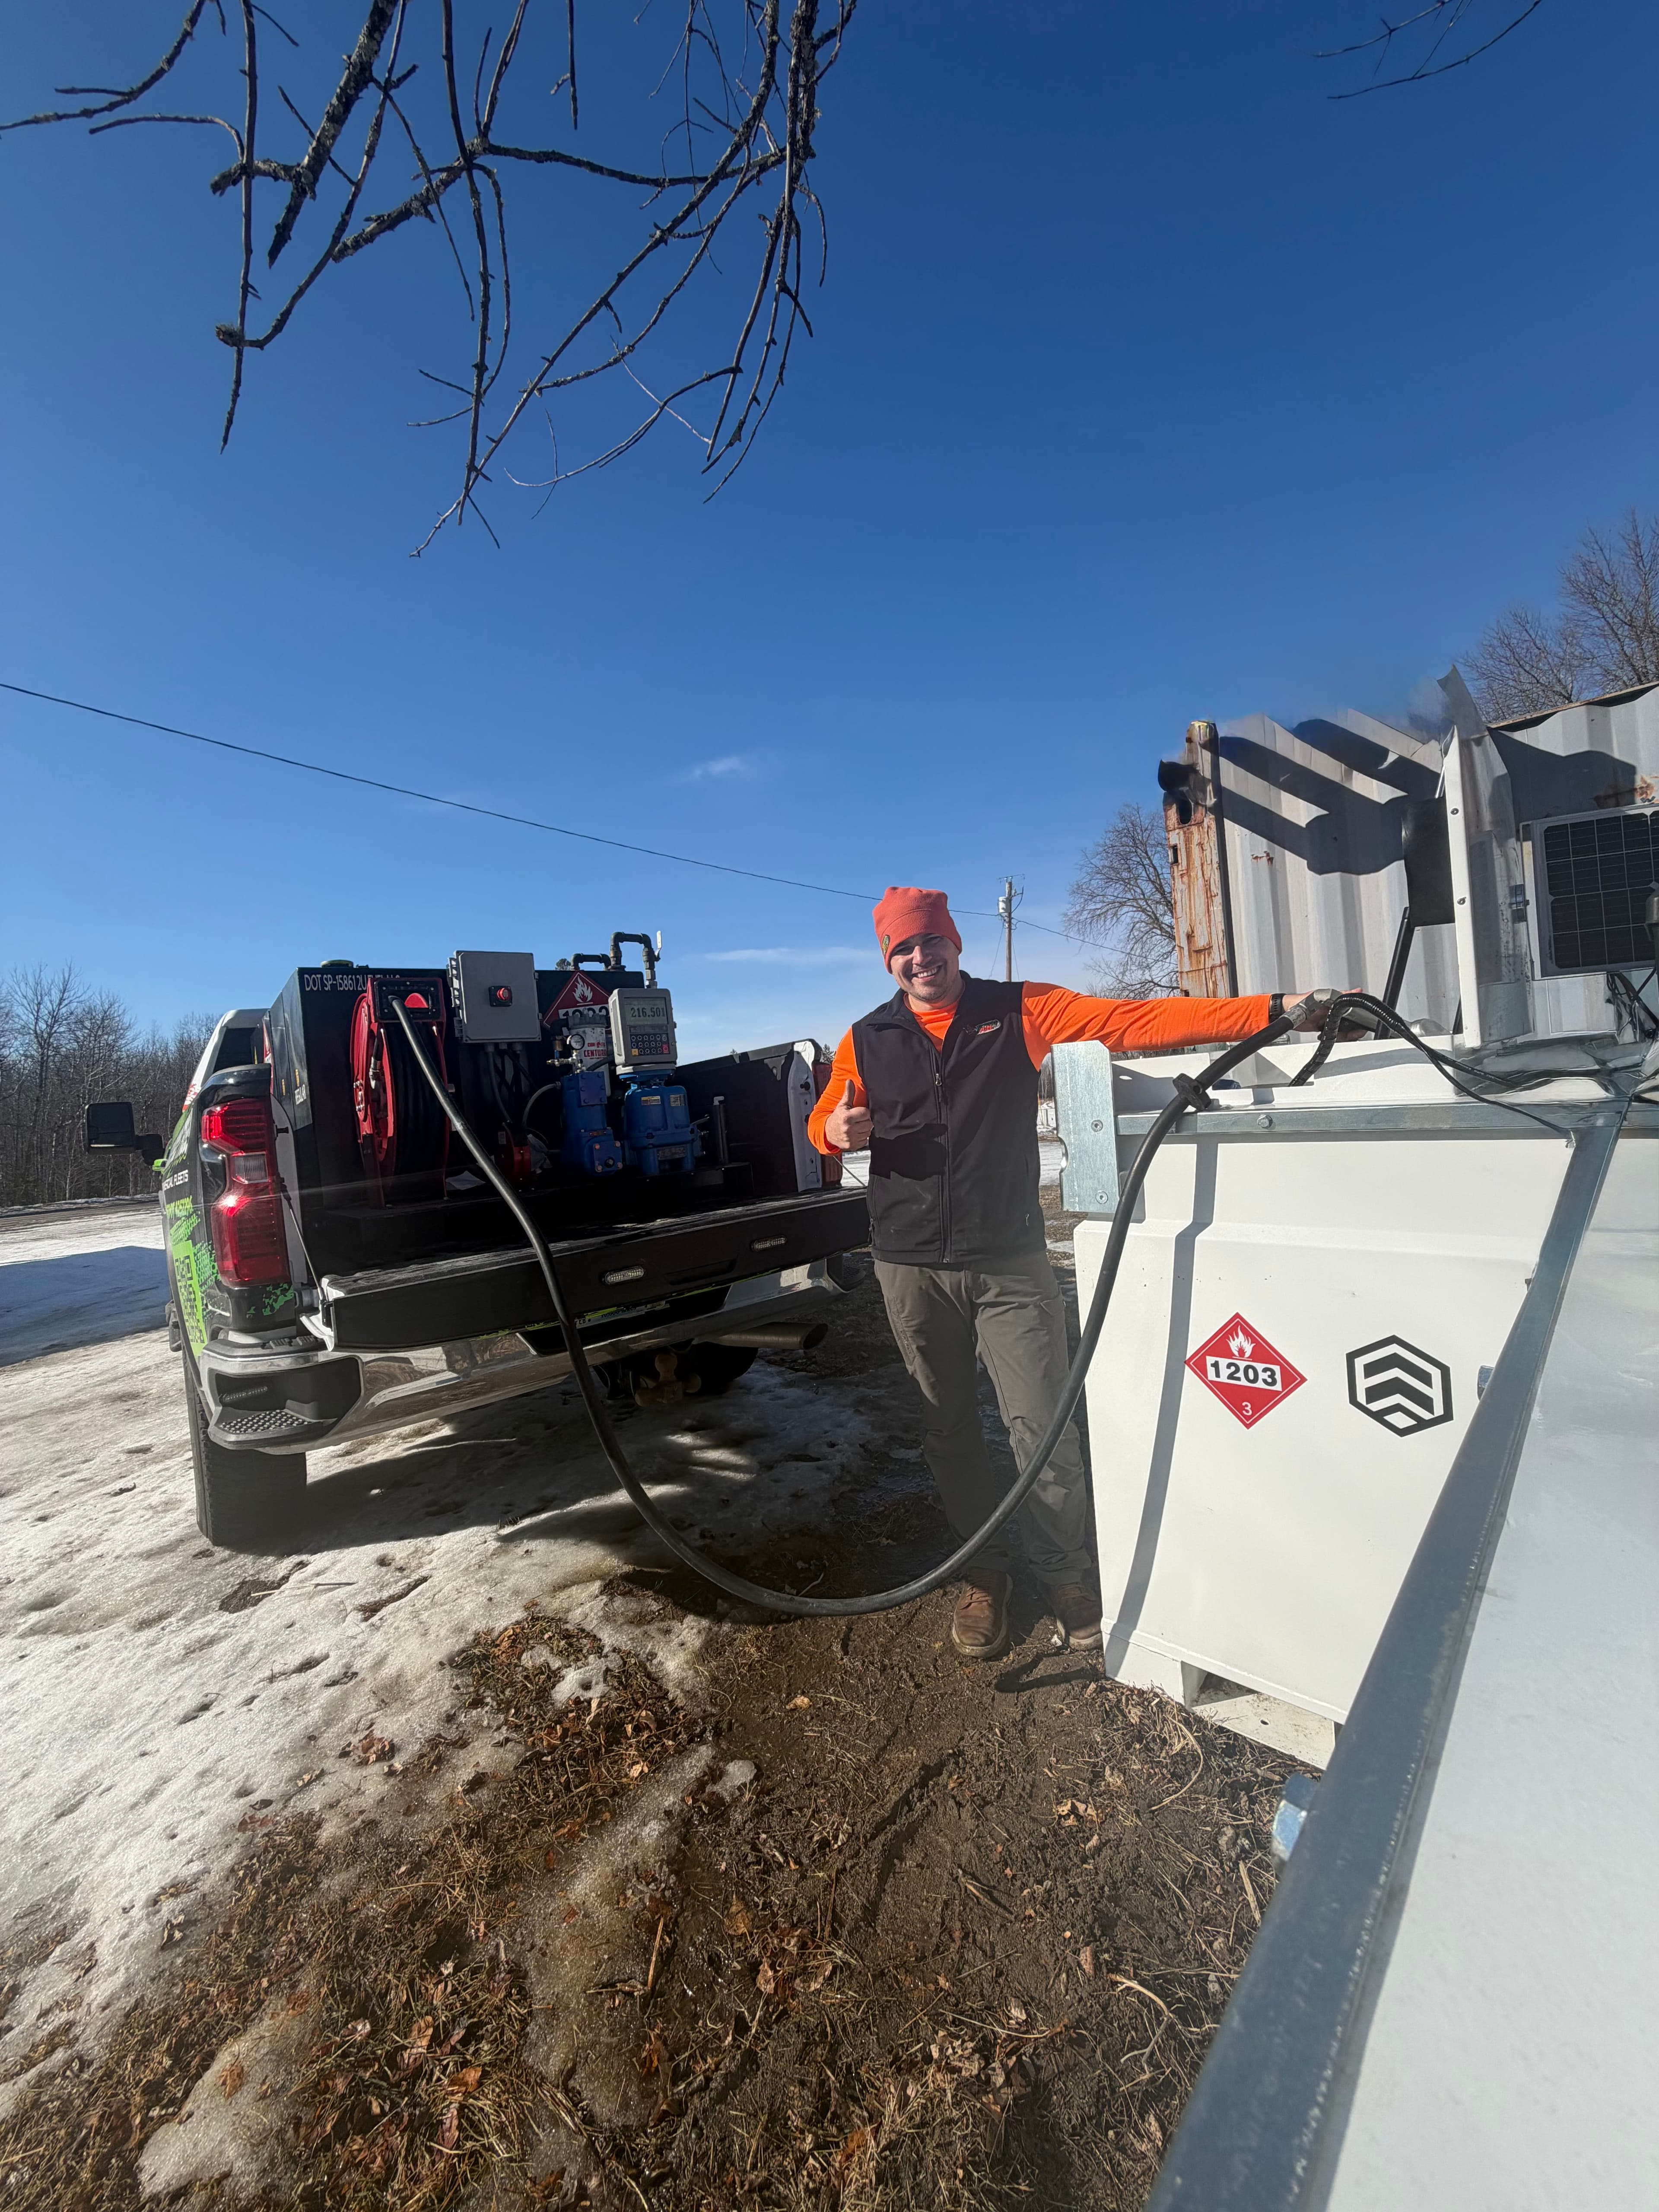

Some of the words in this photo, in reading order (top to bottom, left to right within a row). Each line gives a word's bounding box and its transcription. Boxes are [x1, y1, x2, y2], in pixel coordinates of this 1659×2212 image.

[304, 975, 321, 991] DOT
[174, 1169, 188, 1186] FLEETS
[1211, 1360, 1277, 1386] 1203
[1242, 1402, 1252, 1415] 3
